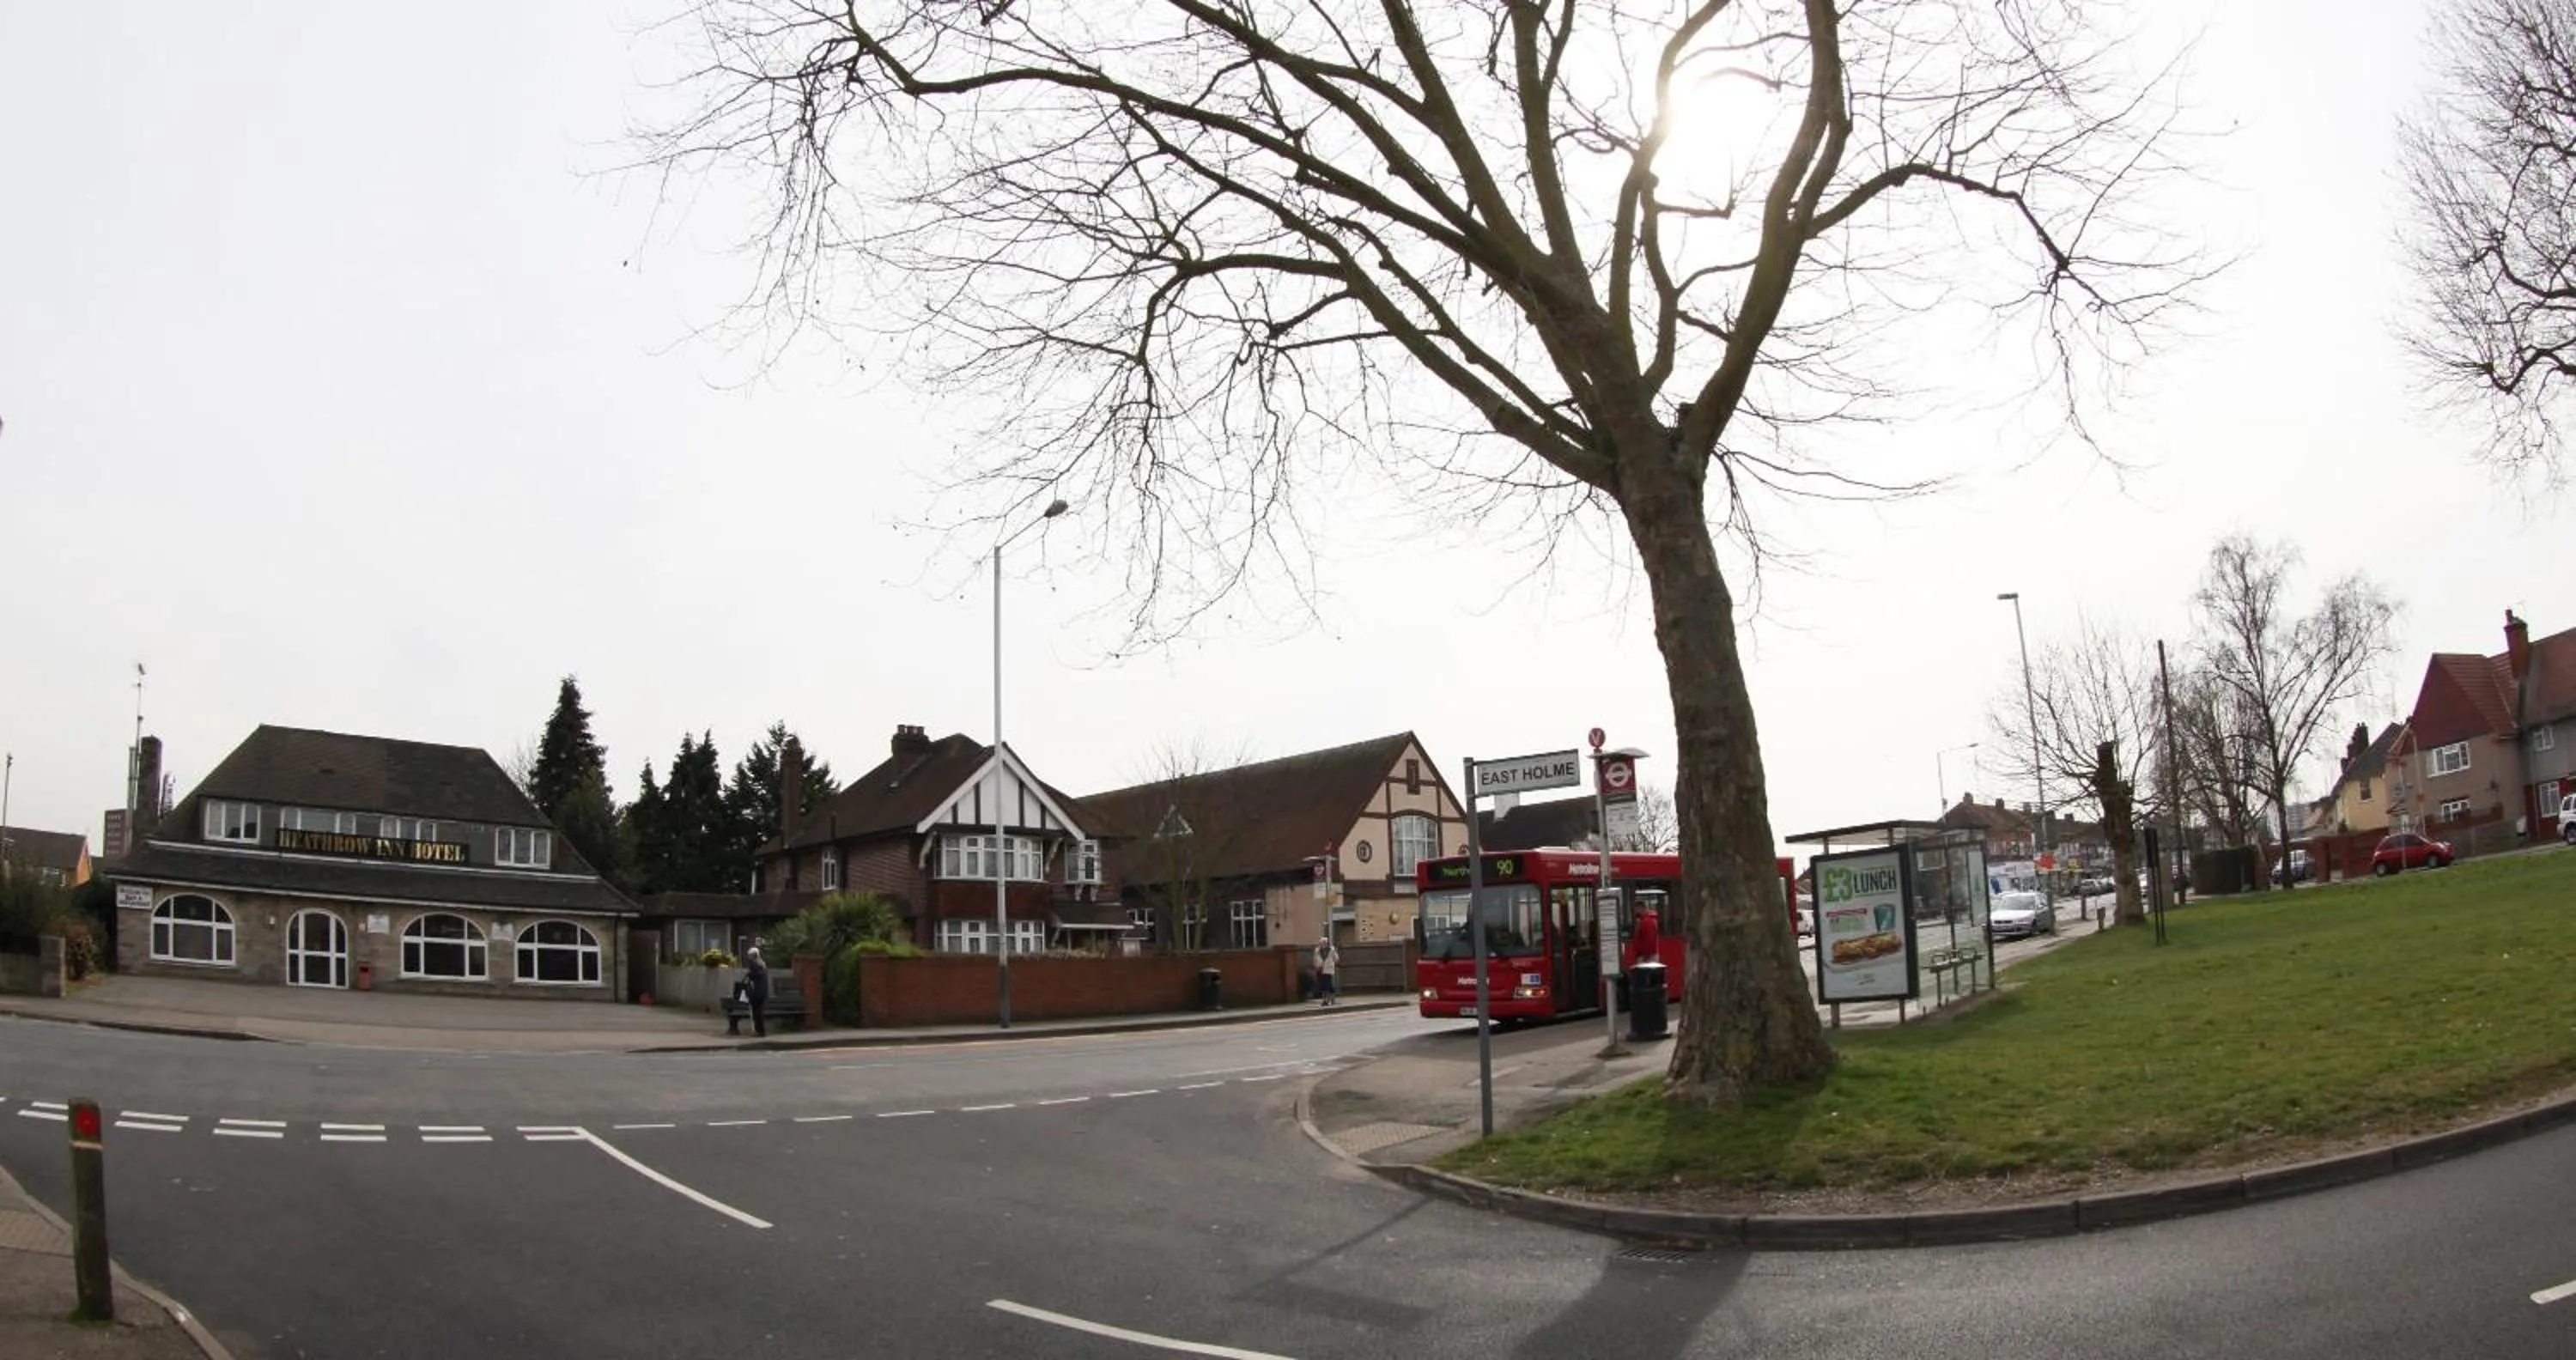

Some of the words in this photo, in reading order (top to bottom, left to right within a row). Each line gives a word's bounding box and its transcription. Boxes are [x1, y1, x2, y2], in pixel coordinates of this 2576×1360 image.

[1481, 768, 1518, 786] EAST
[1522, 762, 1575, 780] HOLME
[279, 829, 371, 853] HEATHROW
[376, 839, 406, 857] INN
[411, 841, 465, 862] HOTEL
[1497, 859, 1513, 875] 90
[1823, 867, 1853, 903] £3
[1854, 868, 1897, 894] LUNCH
